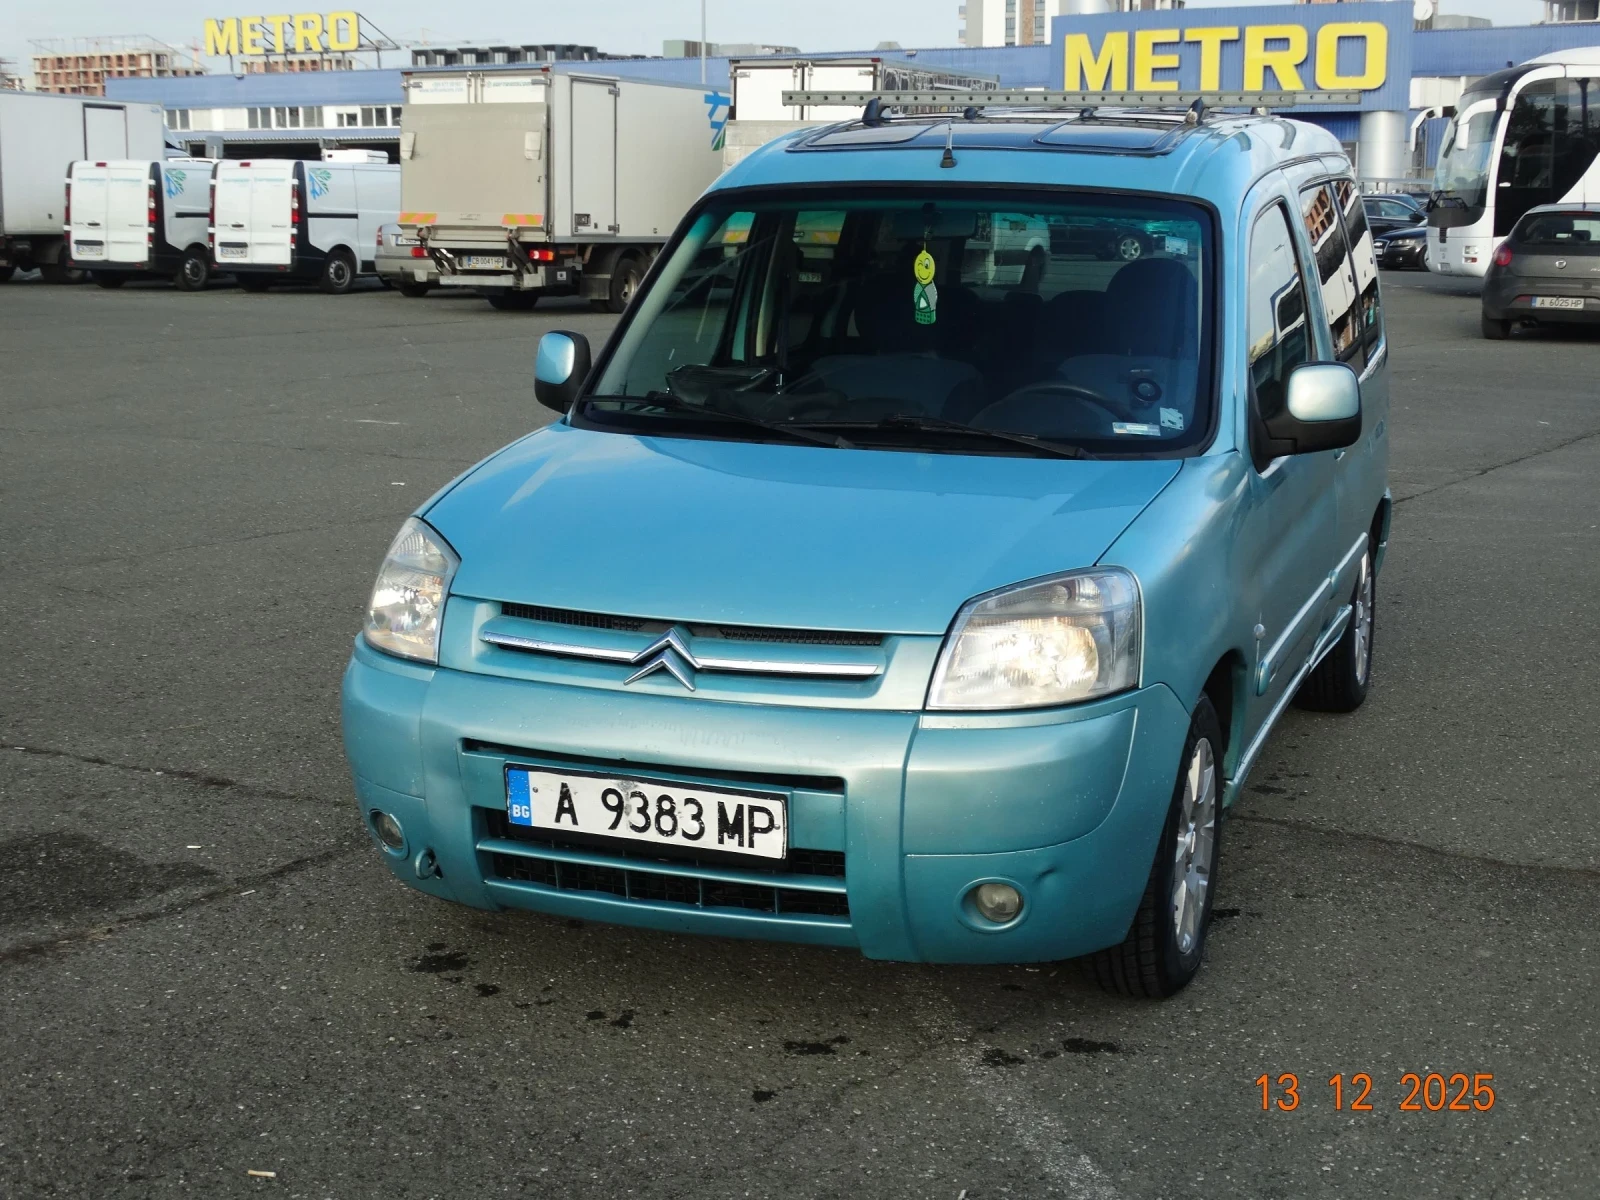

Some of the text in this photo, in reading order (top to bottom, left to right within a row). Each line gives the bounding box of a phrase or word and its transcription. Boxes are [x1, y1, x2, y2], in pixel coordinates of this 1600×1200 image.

[205, 10, 358, 56] METRO
[1064, 21, 1388, 91] METRO
[1549, 299, 1569, 307] 6025
[512, 804, 530, 818] BG
[554, 782, 775, 848] A 9383 MP
